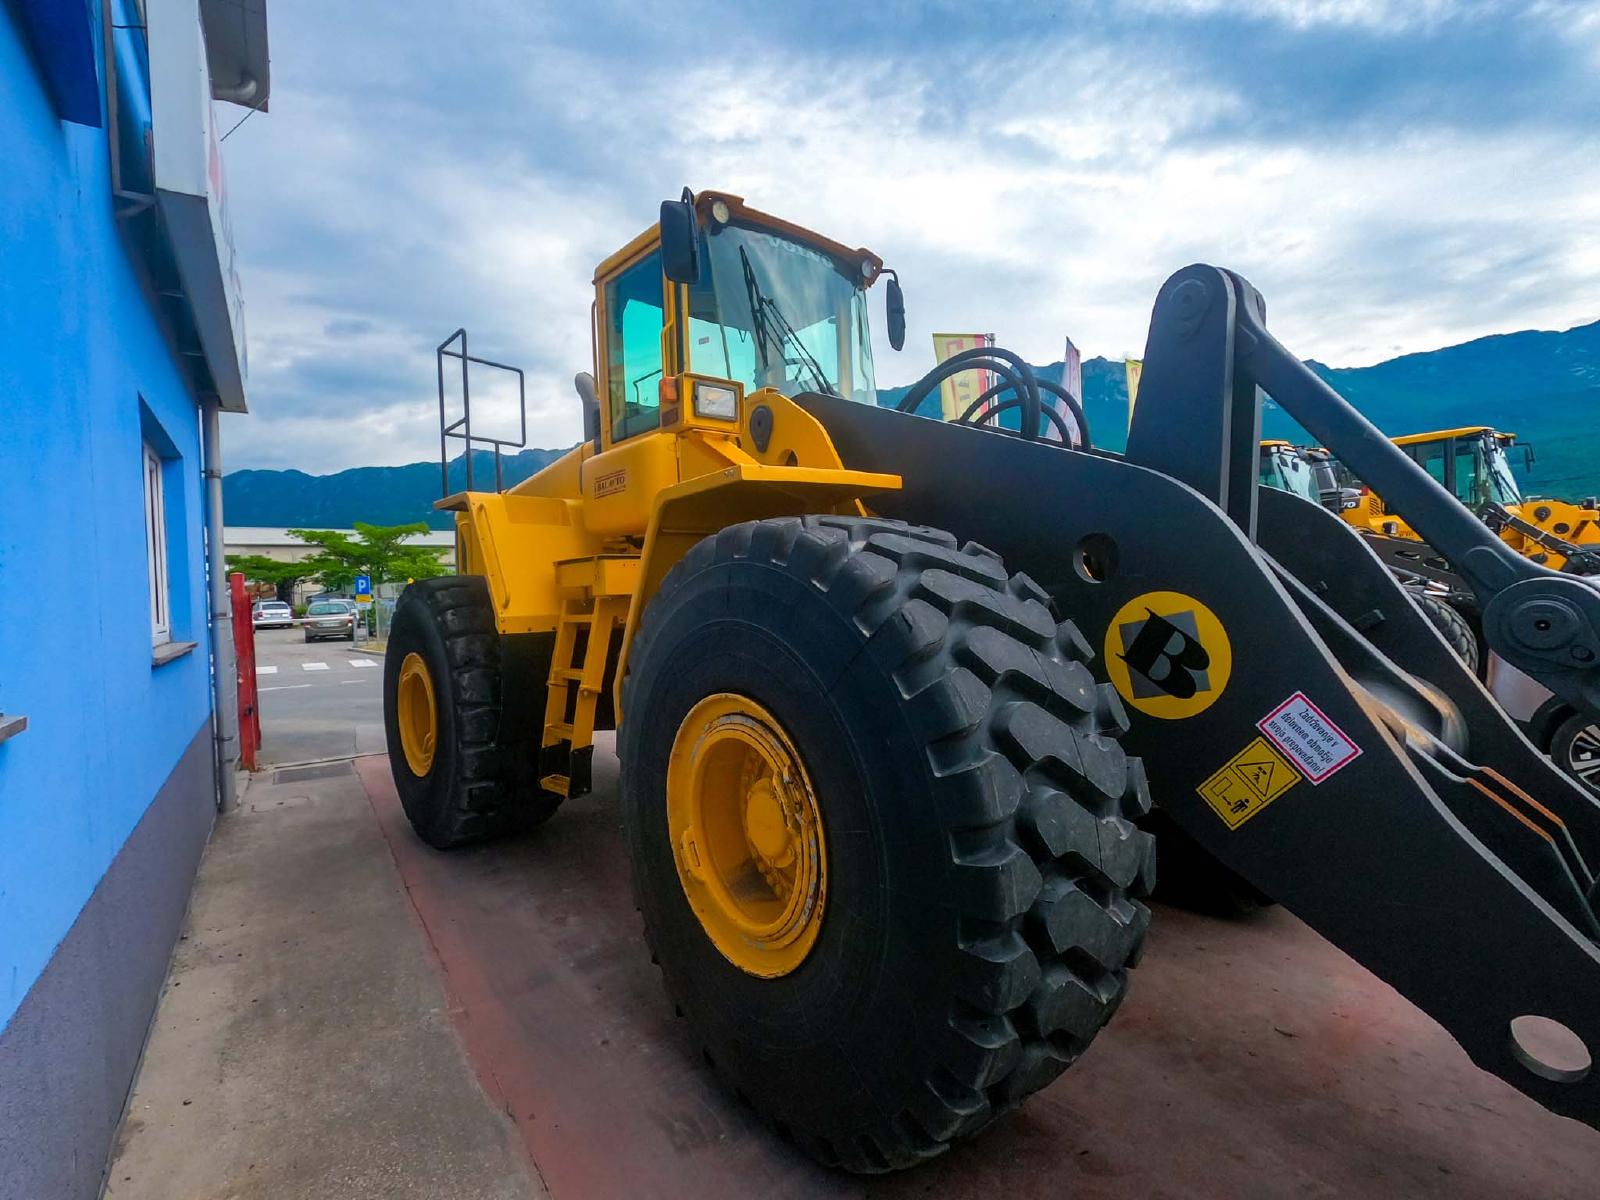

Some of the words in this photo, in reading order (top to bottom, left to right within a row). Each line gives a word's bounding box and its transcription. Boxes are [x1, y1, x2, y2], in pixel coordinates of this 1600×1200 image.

[358, 579, 366, 593] P
[1115, 607, 1210, 699] B
[1281, 712, 1310, 740] delovnem
[1268, 720, 1287, 738] stroja
[1283, 735, 1326, 774] prepovedano!
